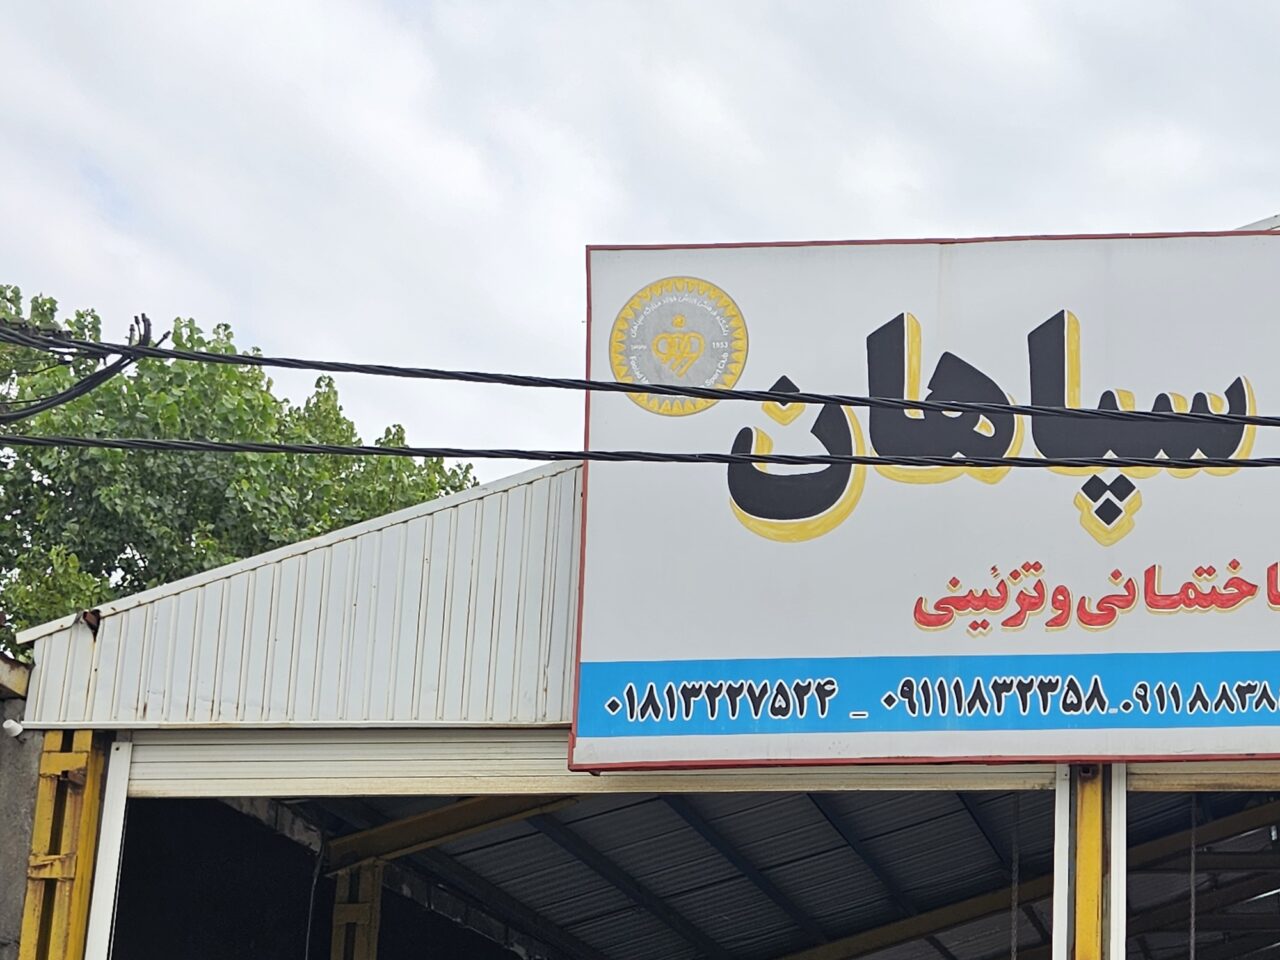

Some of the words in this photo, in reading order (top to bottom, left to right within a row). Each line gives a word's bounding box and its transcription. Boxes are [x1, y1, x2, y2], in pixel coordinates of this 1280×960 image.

[726, 308, 1257, 545] سپاهان
[605, 678, 838, 721] ۰۱۸۱۳۲۲۷۵۲۴
[882, 676, 1108, 716] ۰۹۱۱۱۸۳۲۳۵۸
